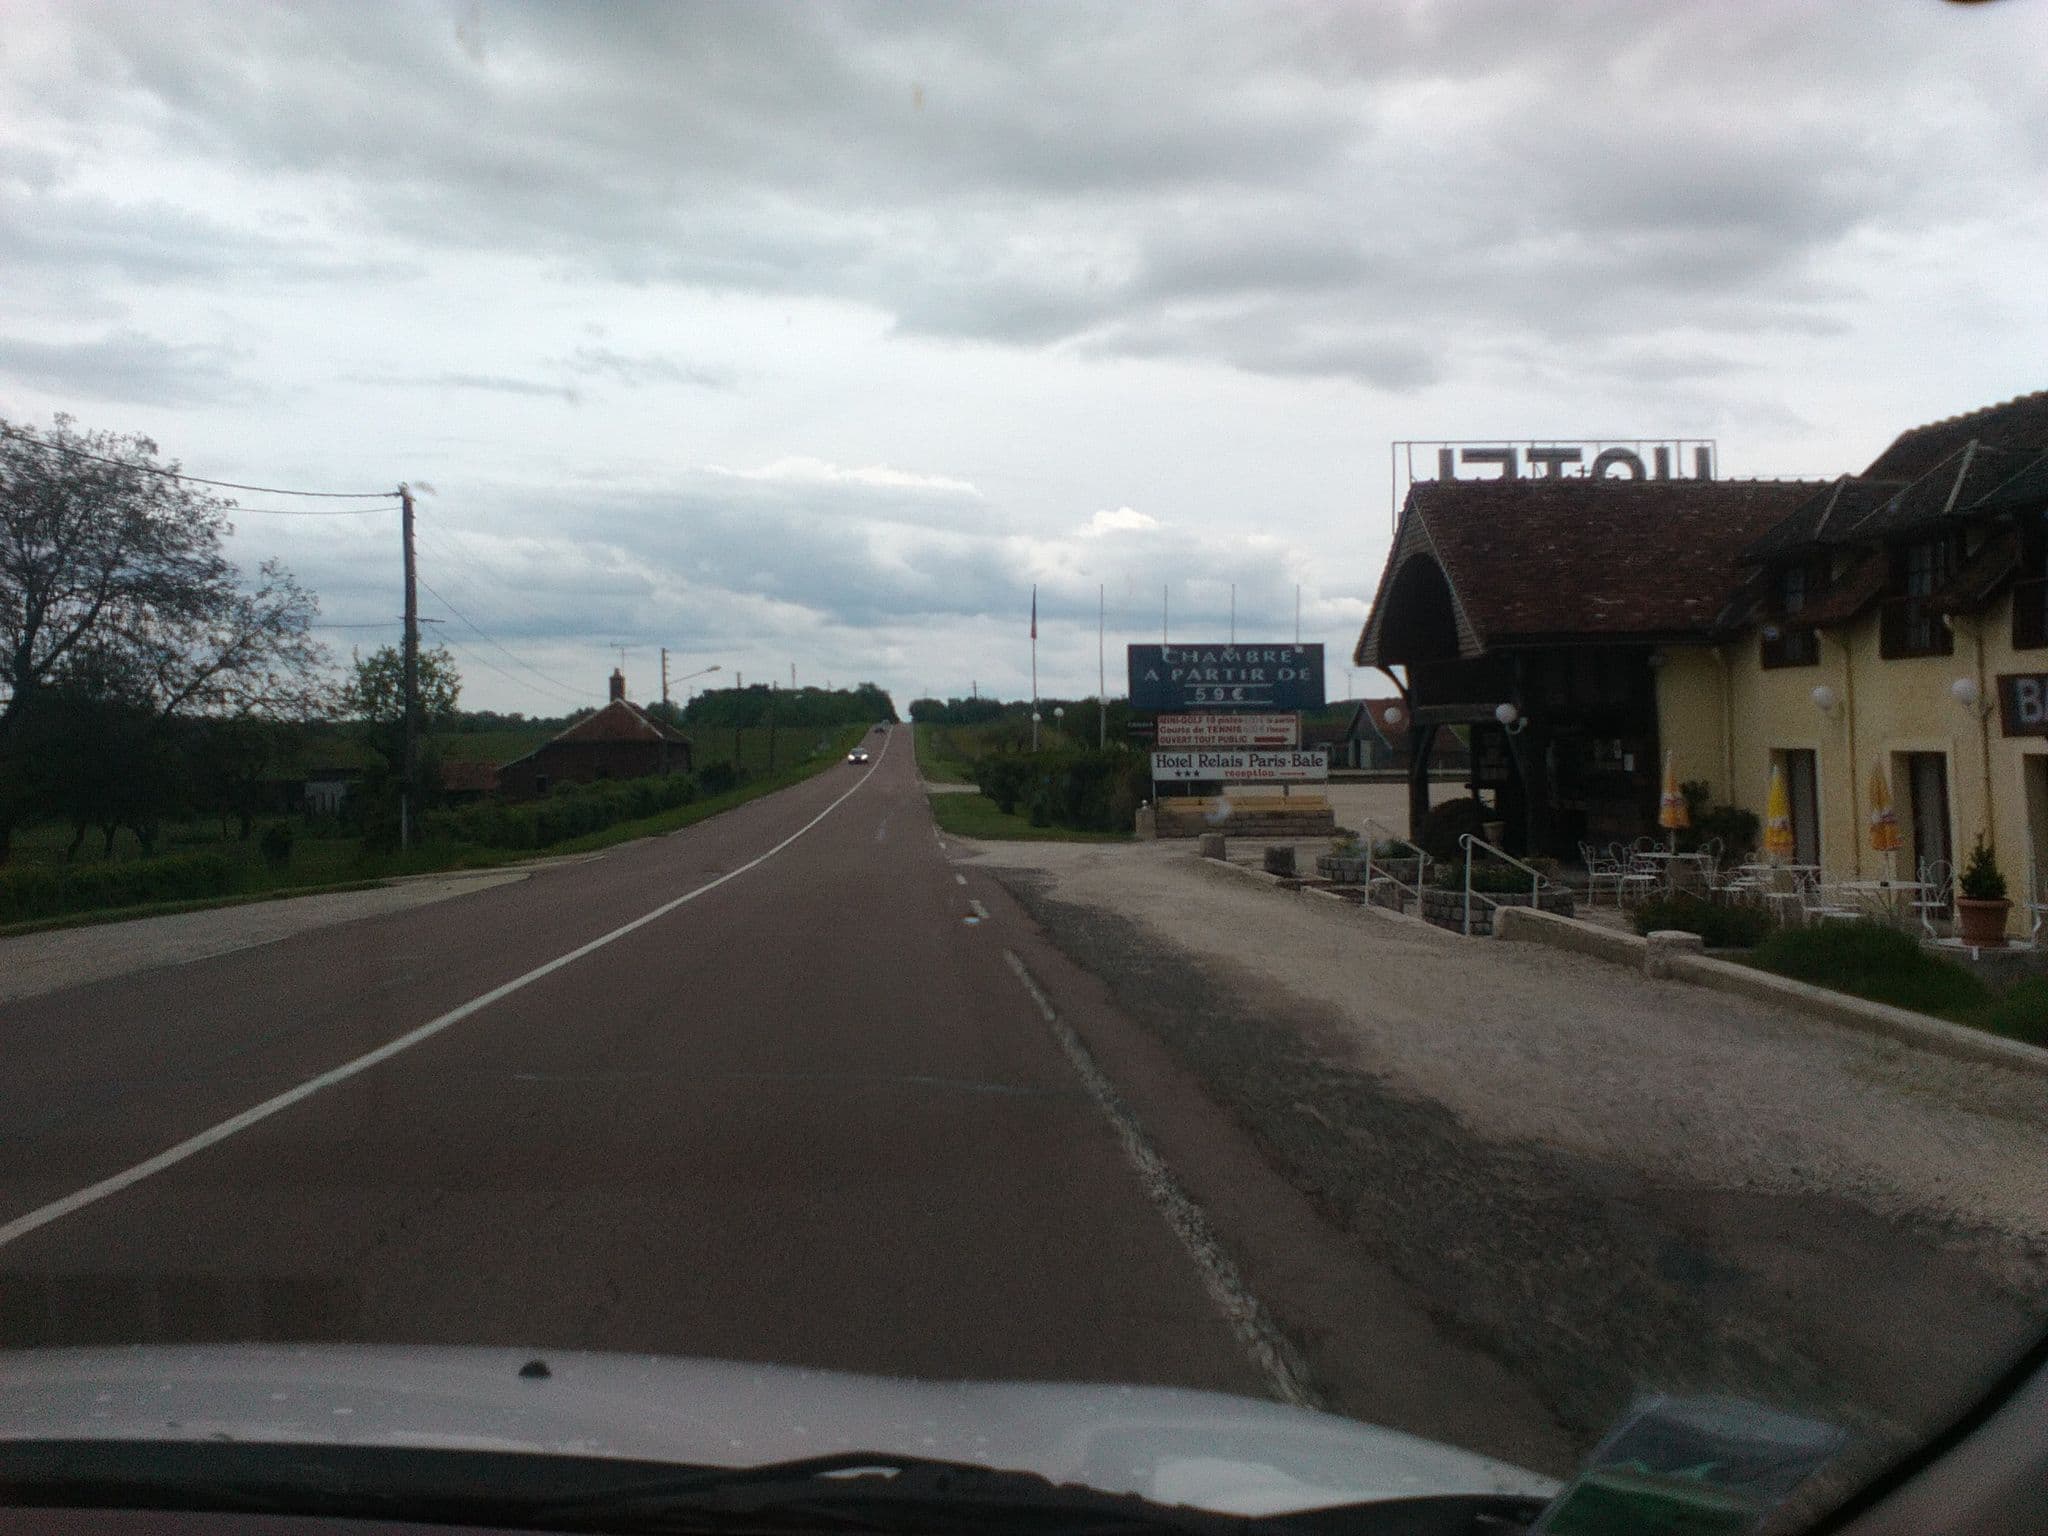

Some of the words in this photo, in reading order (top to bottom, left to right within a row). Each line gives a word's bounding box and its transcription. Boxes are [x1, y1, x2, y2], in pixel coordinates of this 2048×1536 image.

[1162, 648, 1292, 664] CHAMBRE
[1171, 667, 1265, 682] PARTIR
[1277, 667, 1312, 682] DE
[2016, 679, 2048, 721] B
[1207, 725, 1242, 734] TENNIS
[1159, 735, 1191, 744] OUVERT
[1194, 735, 1216, 744] TOUT
[1218, 735, 1247, 744] PUBLIC
[1156, 754, 1192, 768] Hotel
[1198, 754, 1243, 768] Relais
